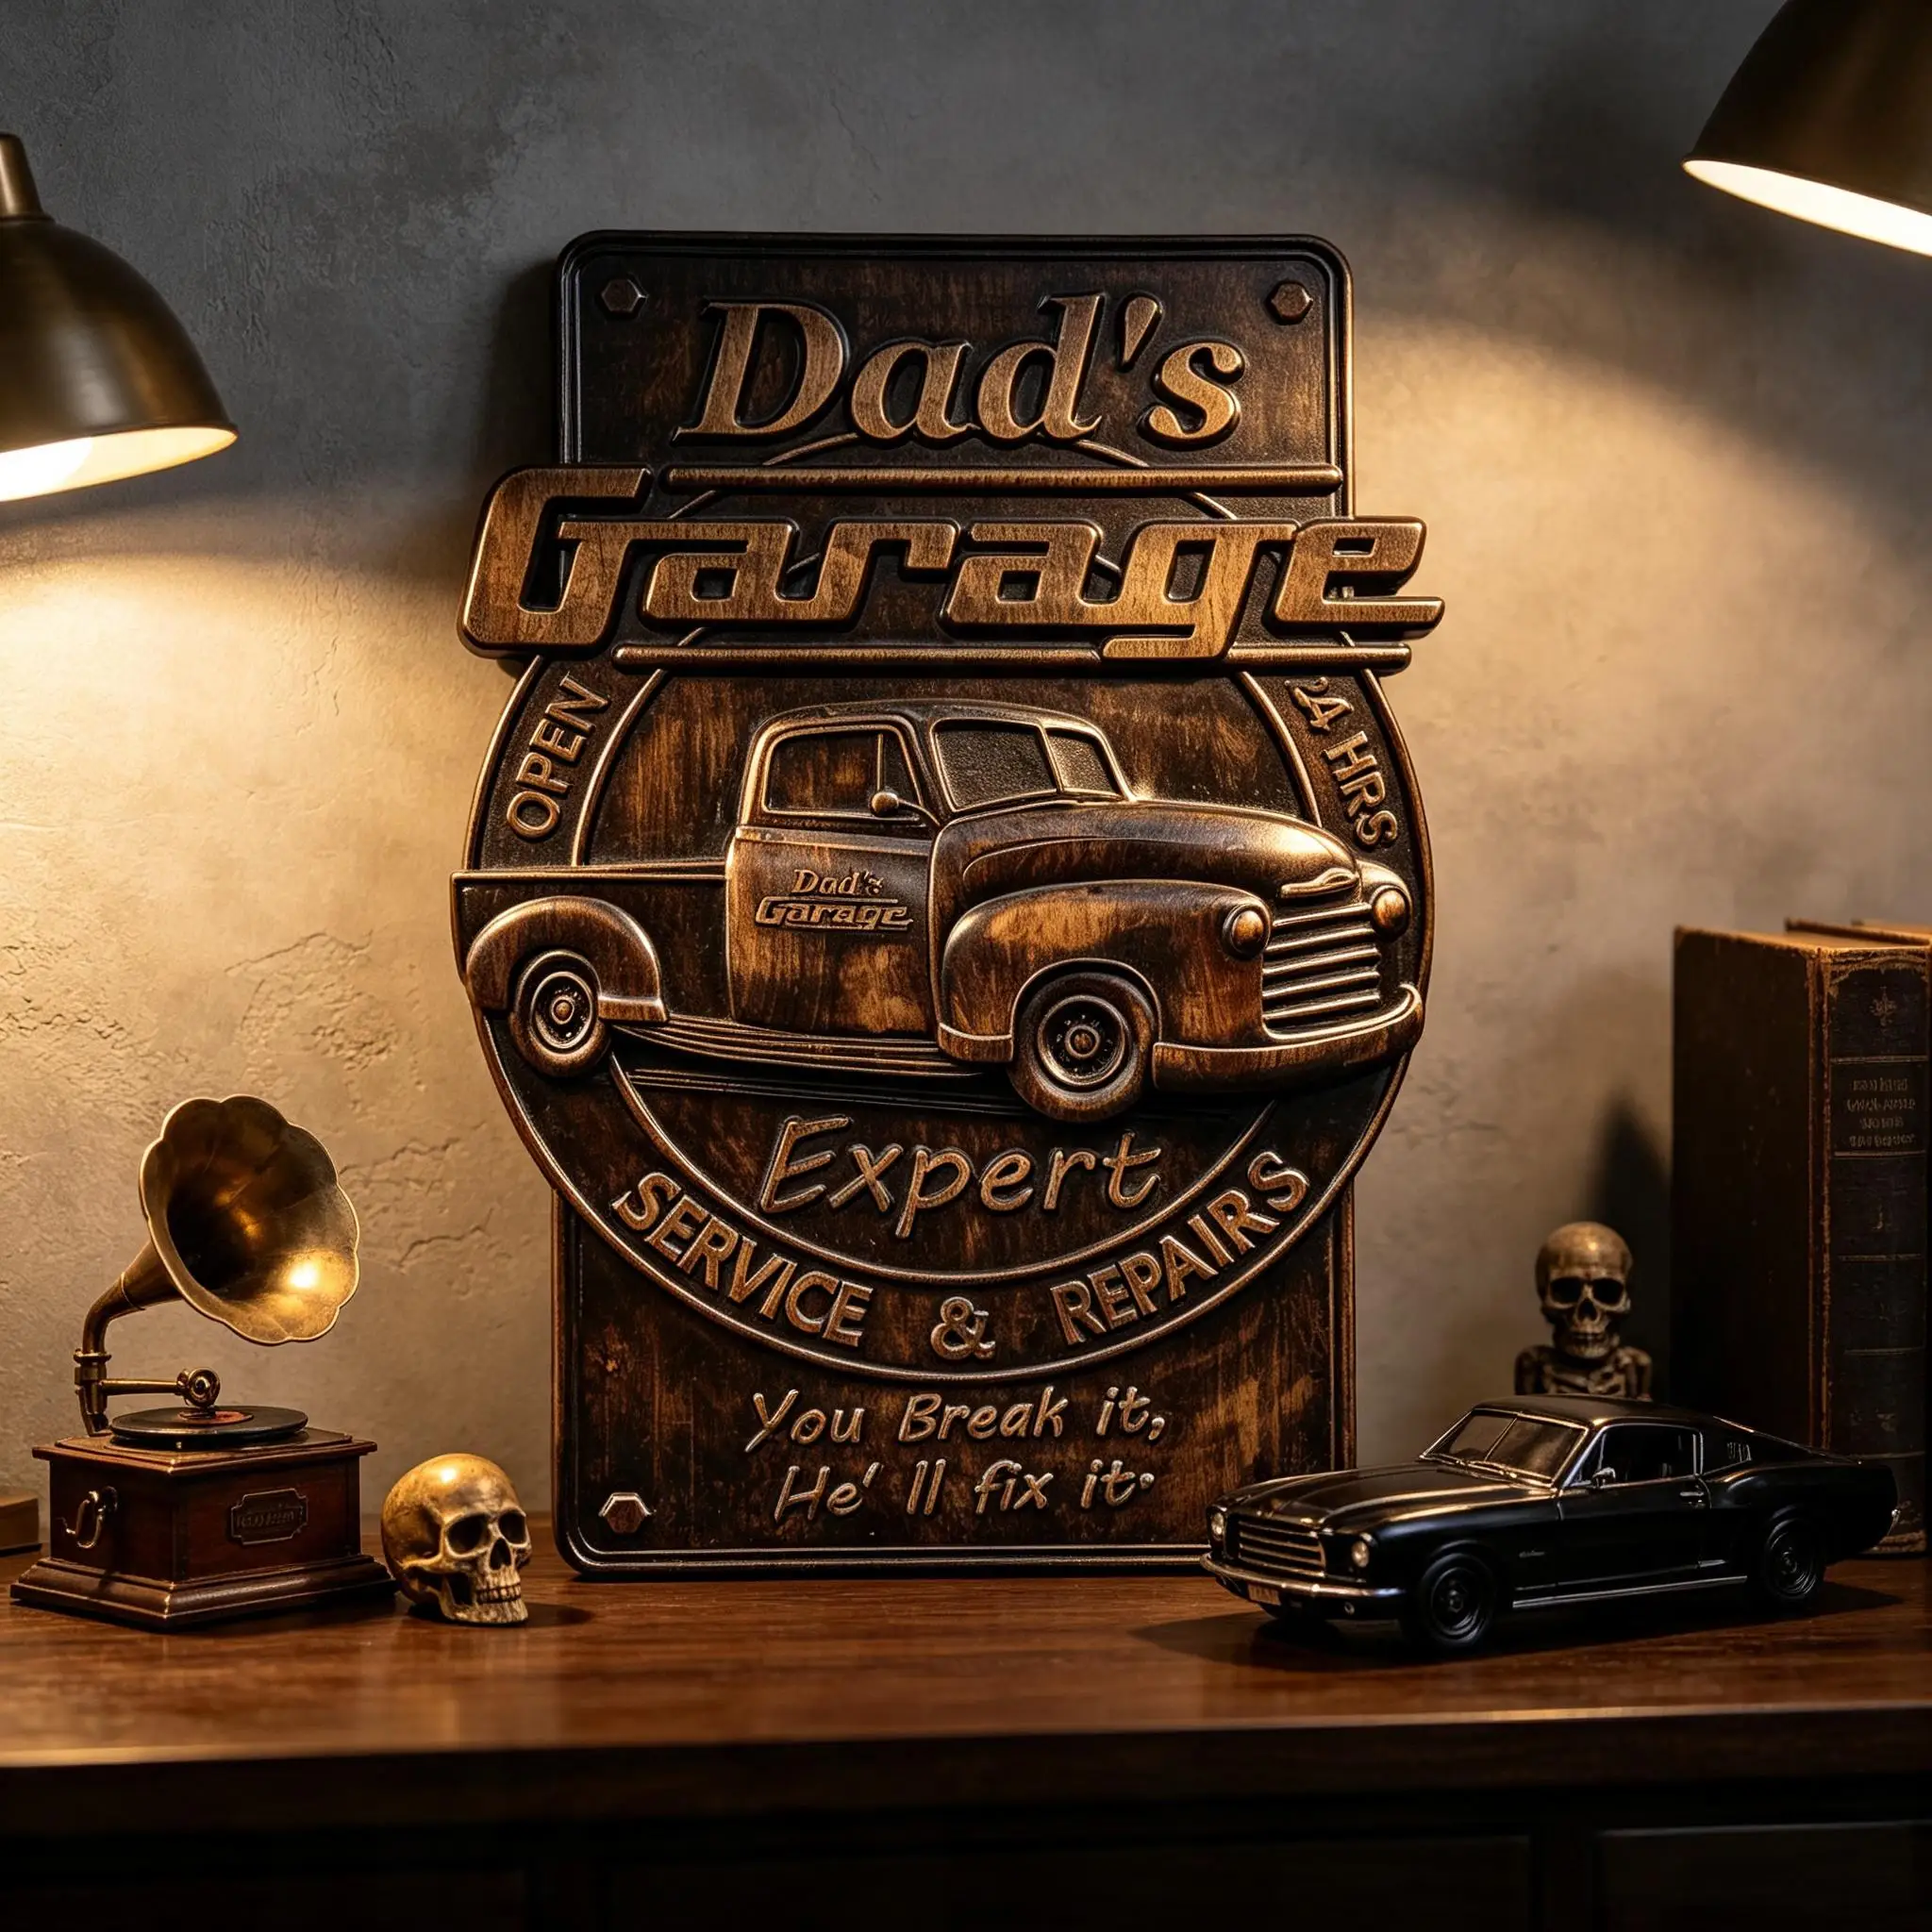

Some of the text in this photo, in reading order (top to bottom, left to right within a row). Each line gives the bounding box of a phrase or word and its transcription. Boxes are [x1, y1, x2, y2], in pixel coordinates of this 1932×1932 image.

[674, 291, 1246, 448] Dad's
[458, 466, 1444, 659] Garage
[507, 673, 610, 839] OPEN
[1322, 730, 1398, 846] HRS
[755, 896, 914, 932] Garage
[759, 1114, 1163, 1239] Expert
[611, 1151, 1310, 1361] SERVICE & REPAIRS
[745, 1388, 865, 1453] You
[899, 1386, 1070, 1443] Break
[975, 1458, 1055, 1514] fix
